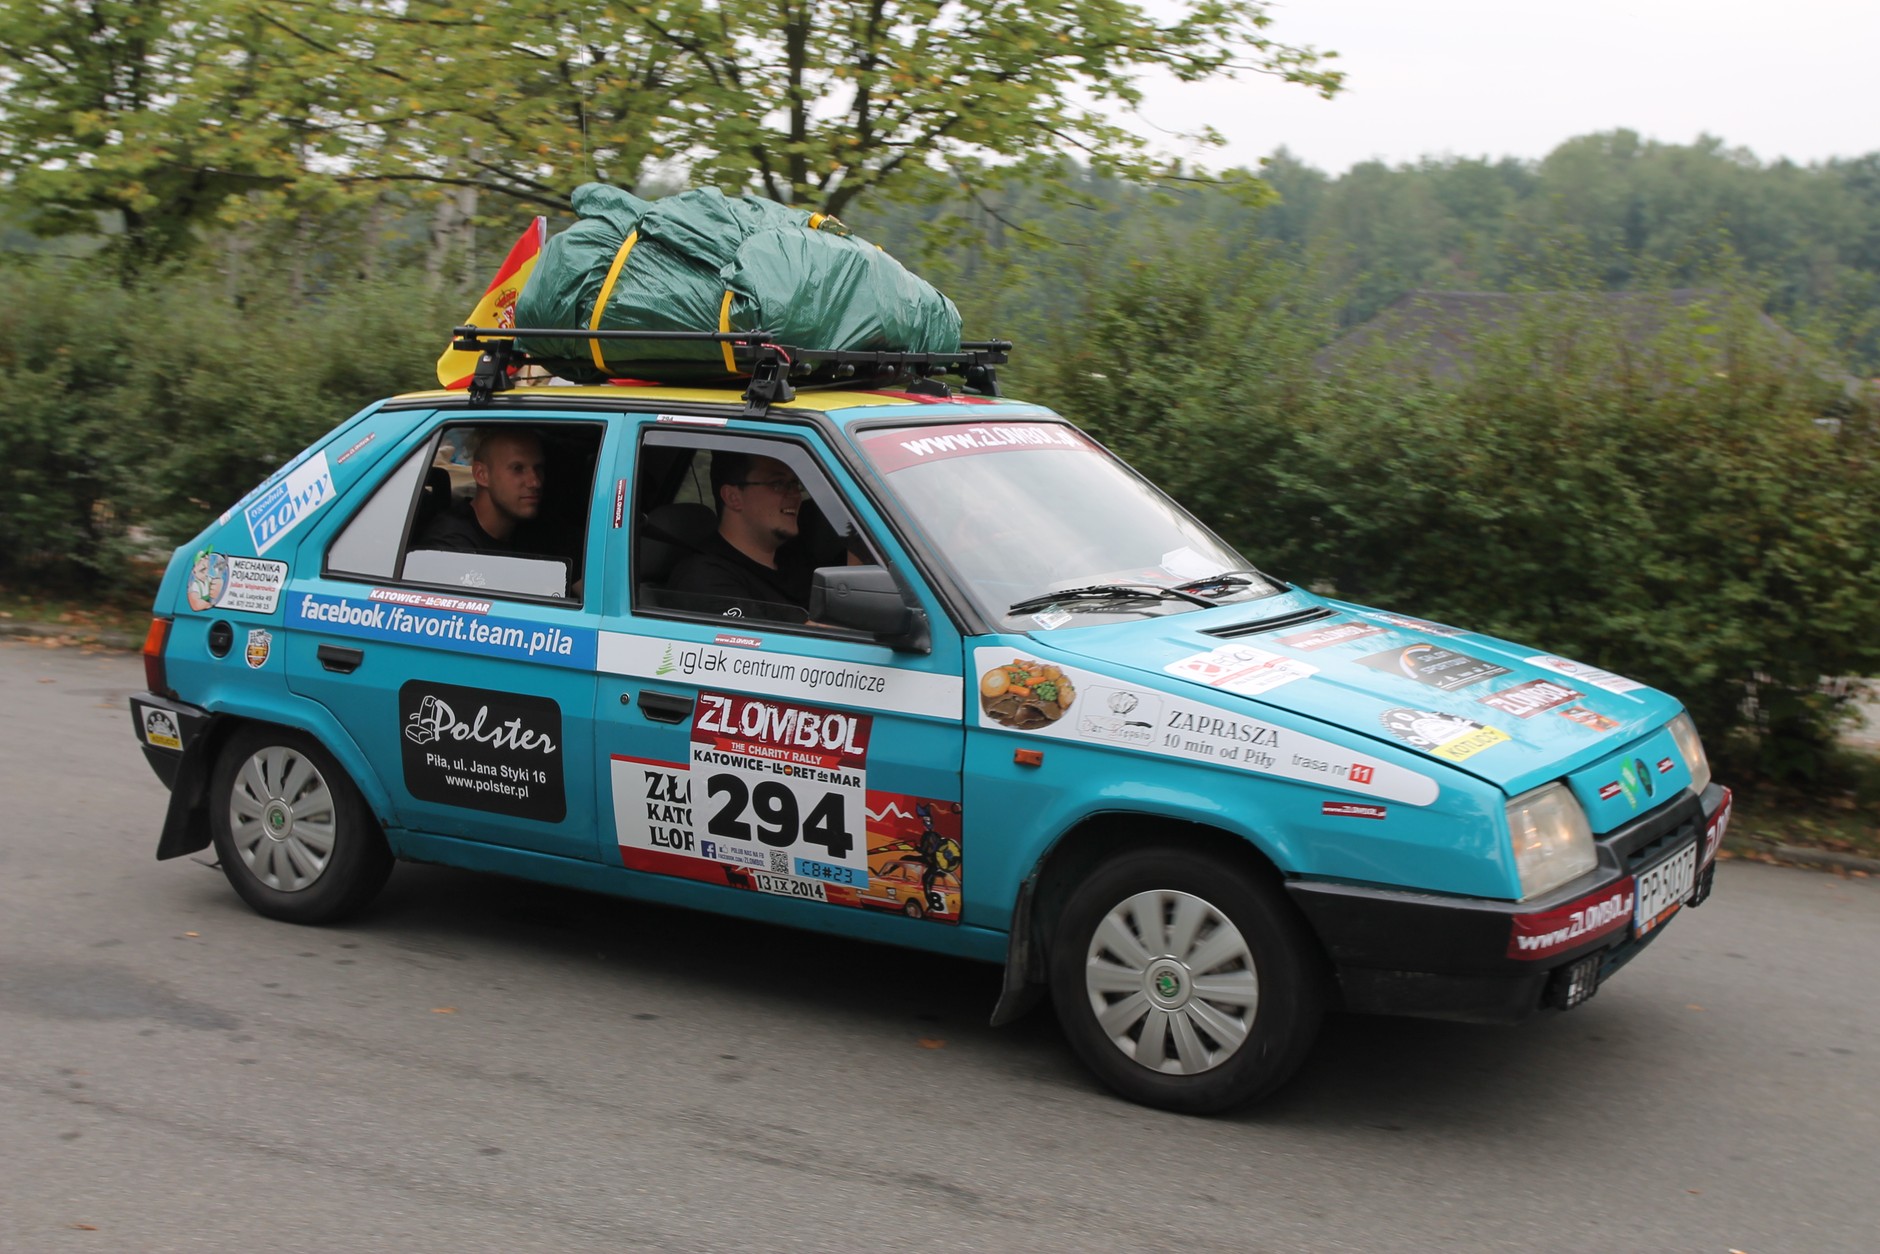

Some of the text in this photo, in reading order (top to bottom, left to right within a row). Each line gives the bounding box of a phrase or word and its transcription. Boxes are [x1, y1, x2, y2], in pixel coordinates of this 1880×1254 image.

[260, 473, 328, 541] nowy
[231, 570, 279, 583] POJAZDOWA
[233, 560, 280, 573] MECHANIKA
[466, 602, 490, 612] MAR
[301, 594, 573, 656] facebook /favorit.team.pila
[679, 648, 885, 693] iglak centrum ogrodnicze
[421, 699, 556, 754] Polster
[697, 693, 864, 754] ZLOMBOL
[1167, 710, 1280, 748] ZAPRASZA
[731, 742, 822, 765] THE CHARITY RALLY
[1162, 733, 1276, 769] 10 min od Piły
[426, 753, 546, 783] Piła, ul. Jana Styki 16
[817, 770, 828, 782] de
[829, 773, 861, 788] MAR
[1291, 753, 1369, 782] trasa nr 11
[445, 775, 529, 799] www.polster.pl
[707, 773, 853, 859] 294
[756, 874, 824, 899] 13 IX 2014
